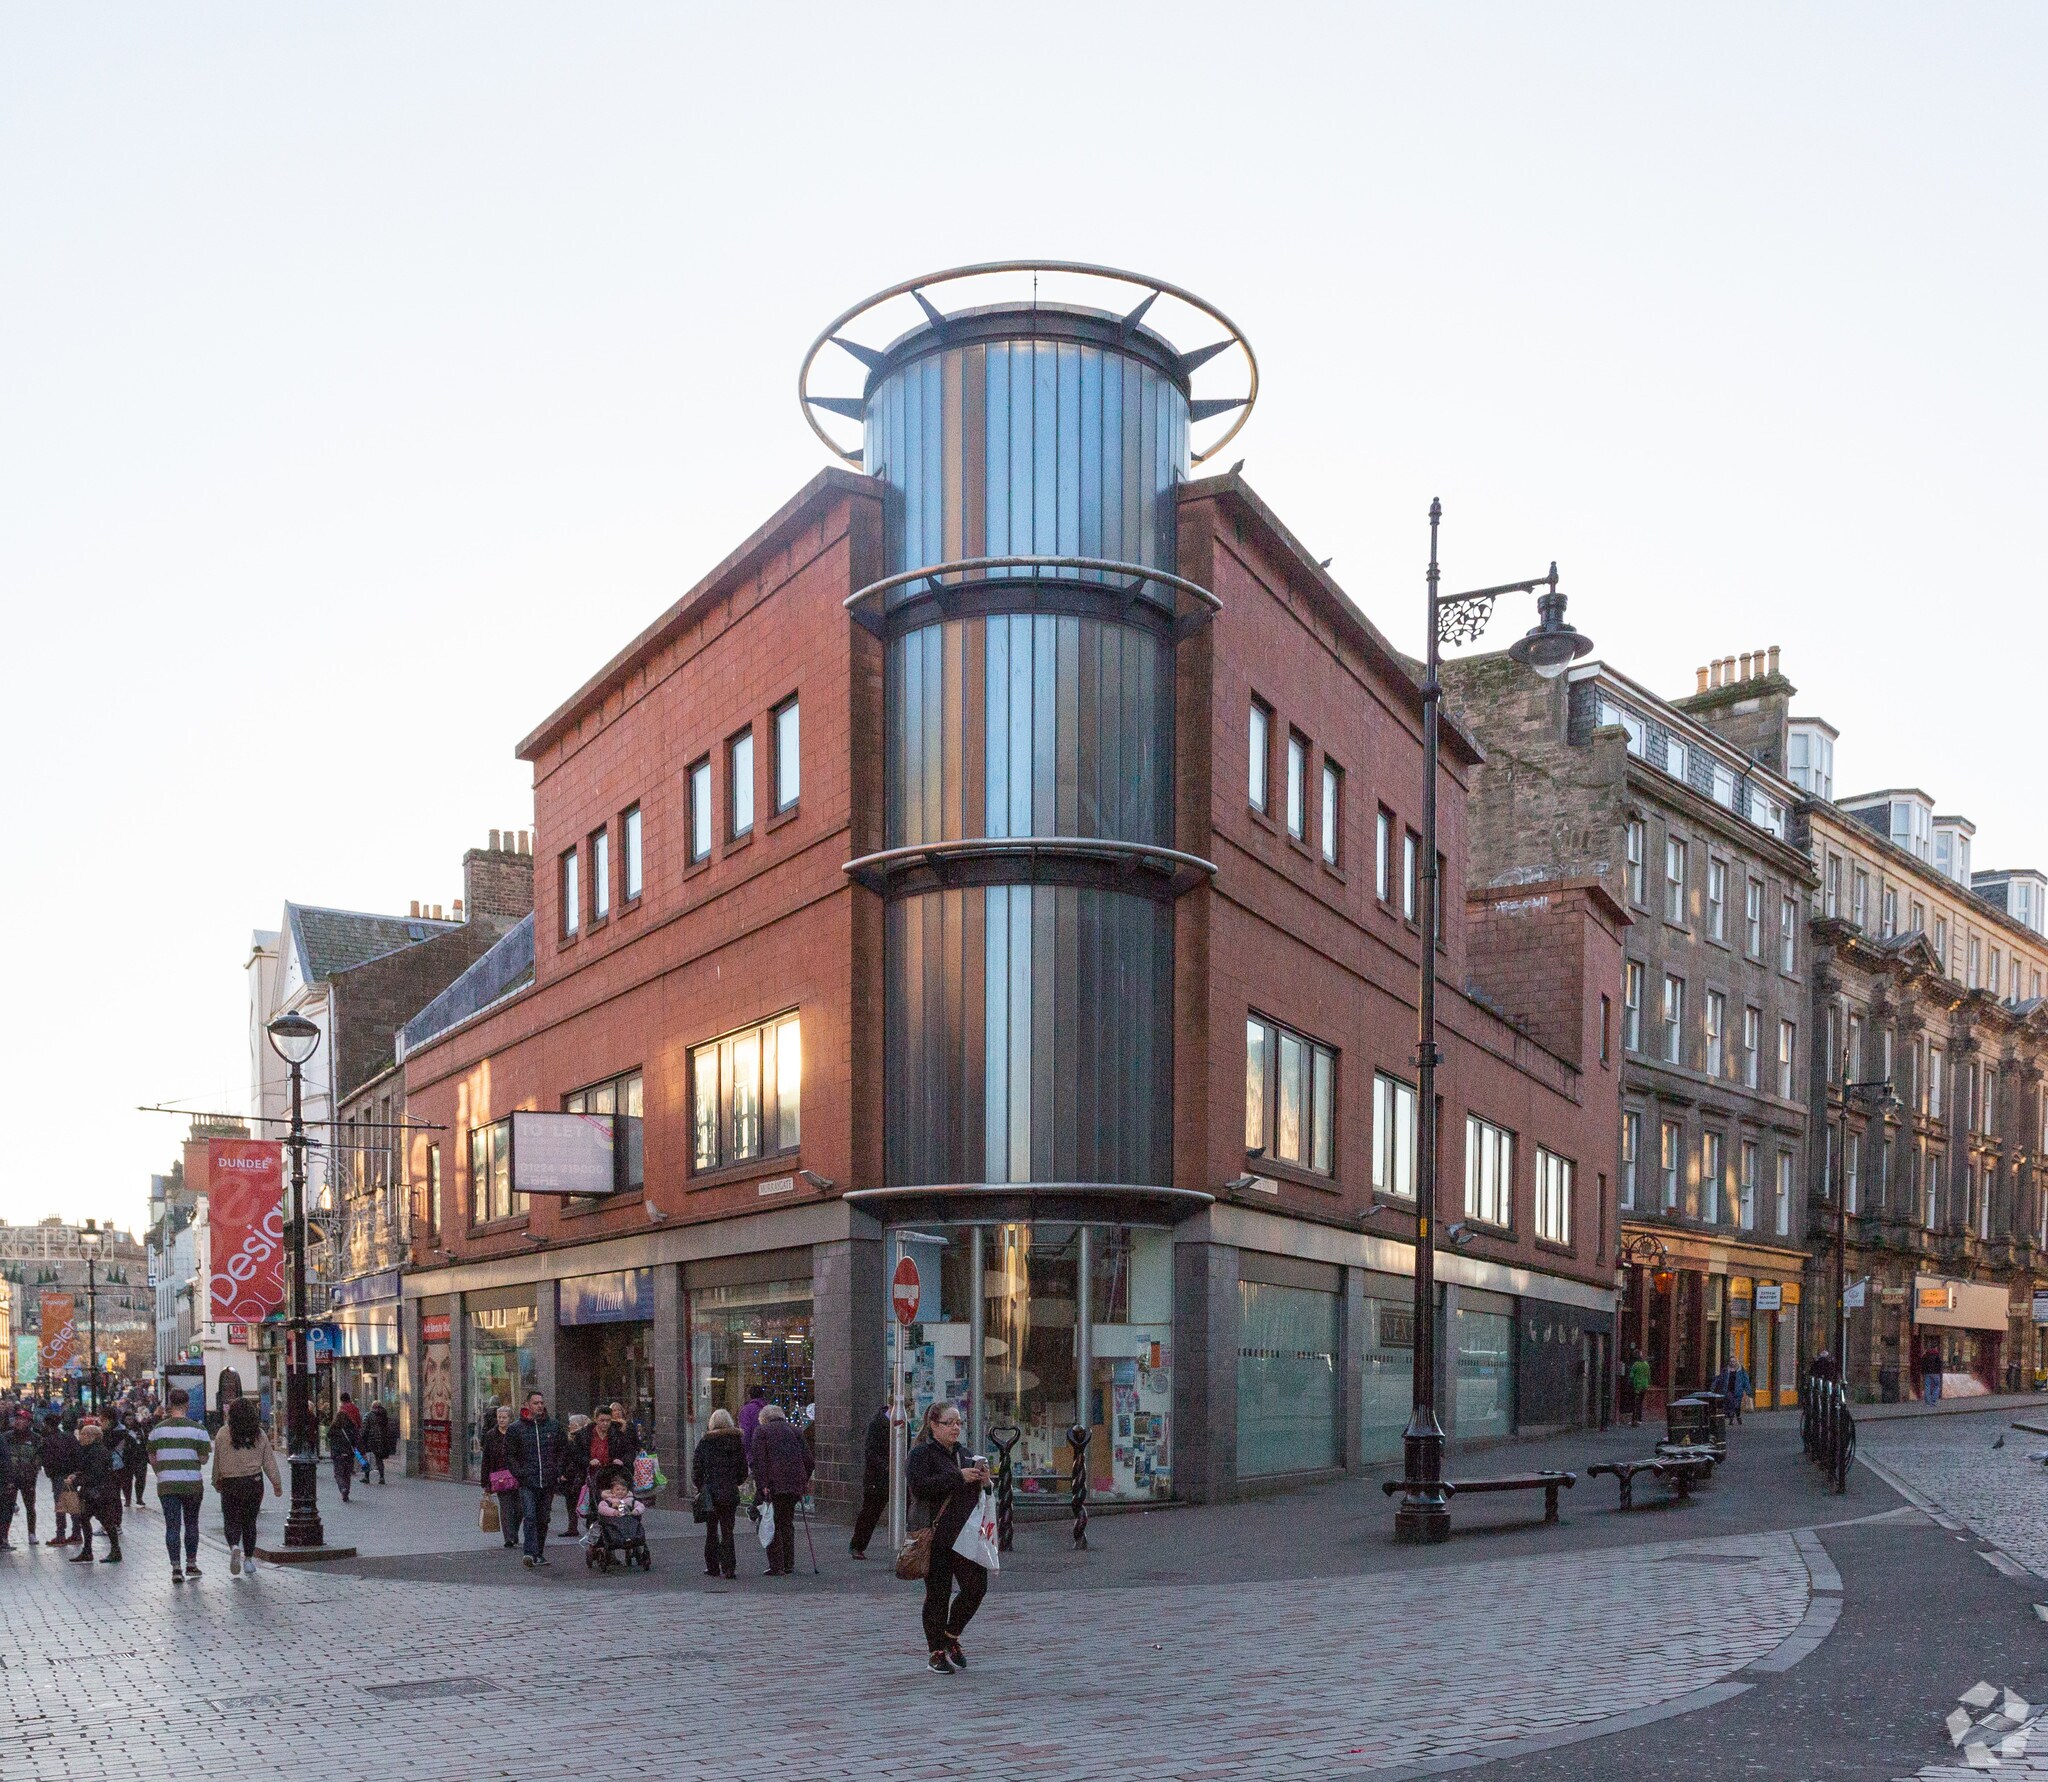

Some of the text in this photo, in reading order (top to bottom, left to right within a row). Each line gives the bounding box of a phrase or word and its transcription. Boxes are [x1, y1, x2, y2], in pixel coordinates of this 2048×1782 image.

[521, 1123, 585, 1138] TO LET
[217, 1157, 269, 1169] DUNDEE
